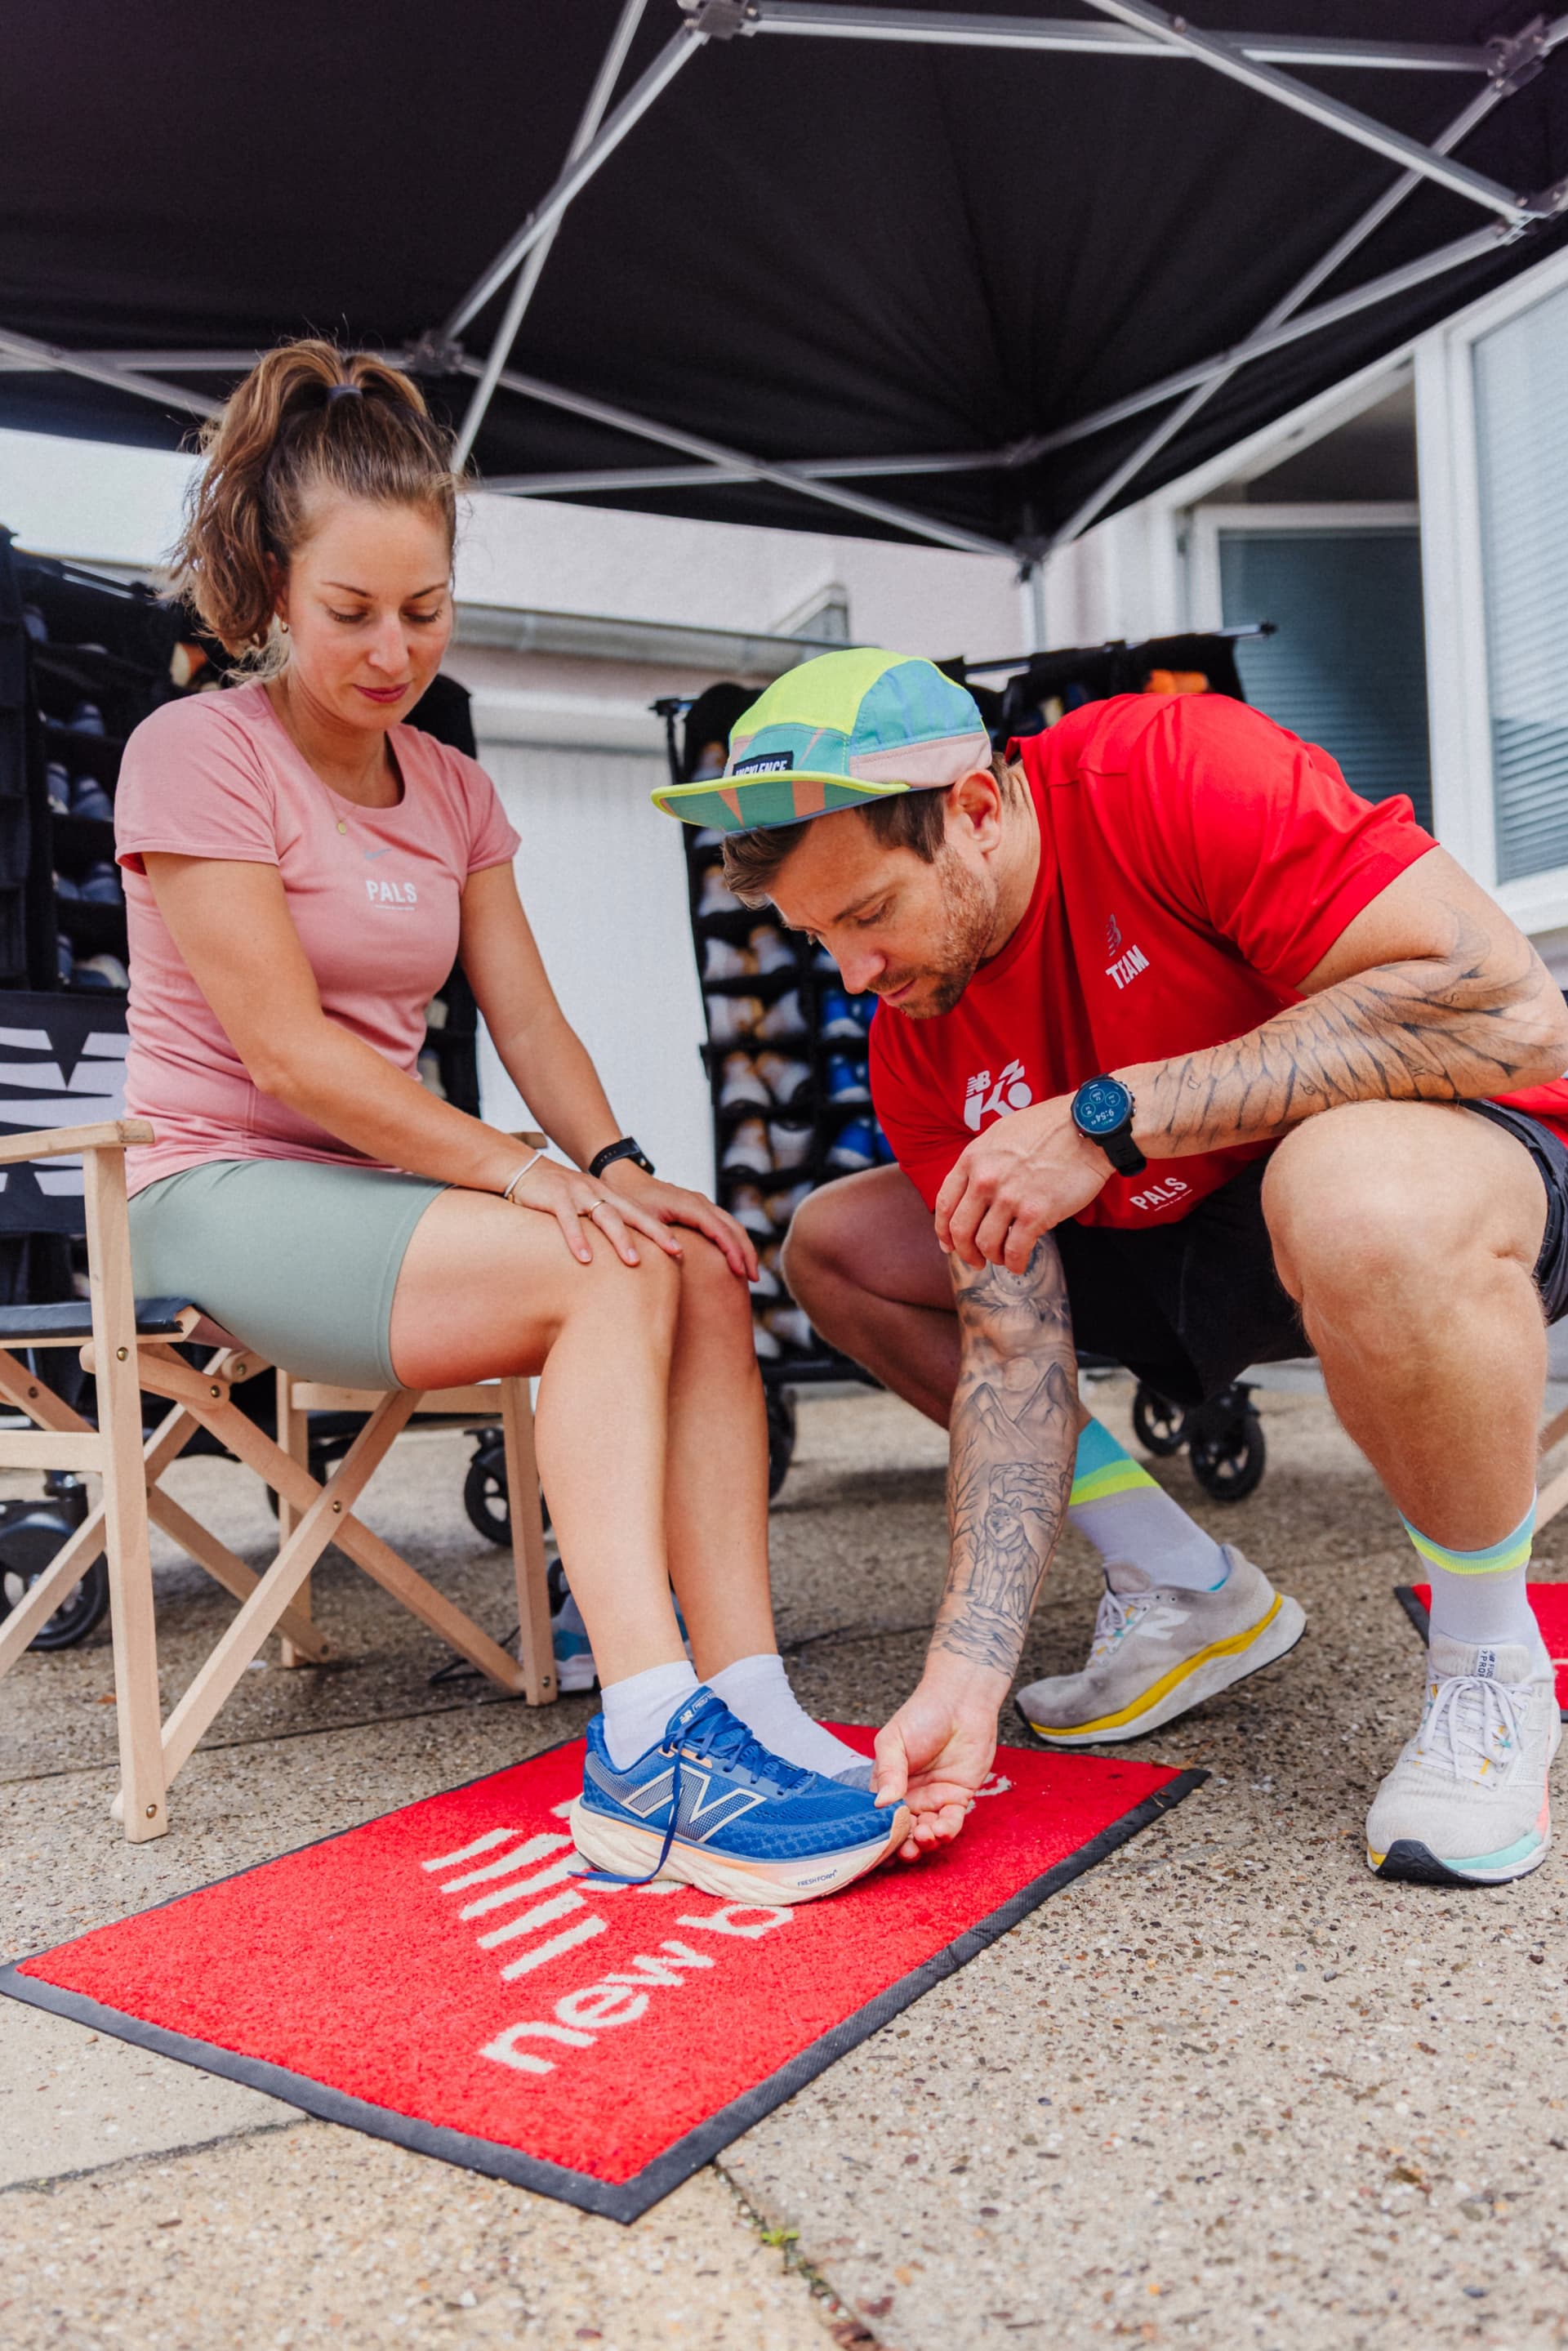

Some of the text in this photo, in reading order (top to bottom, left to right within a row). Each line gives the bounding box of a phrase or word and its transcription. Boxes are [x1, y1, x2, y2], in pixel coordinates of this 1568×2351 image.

[365, 880, 418, 903] PALS
[1105, 944, 1151, 989] TEAM
[1129, 1177, 1187, 1210] PALS
[479, 1940, 715, 2075] new
